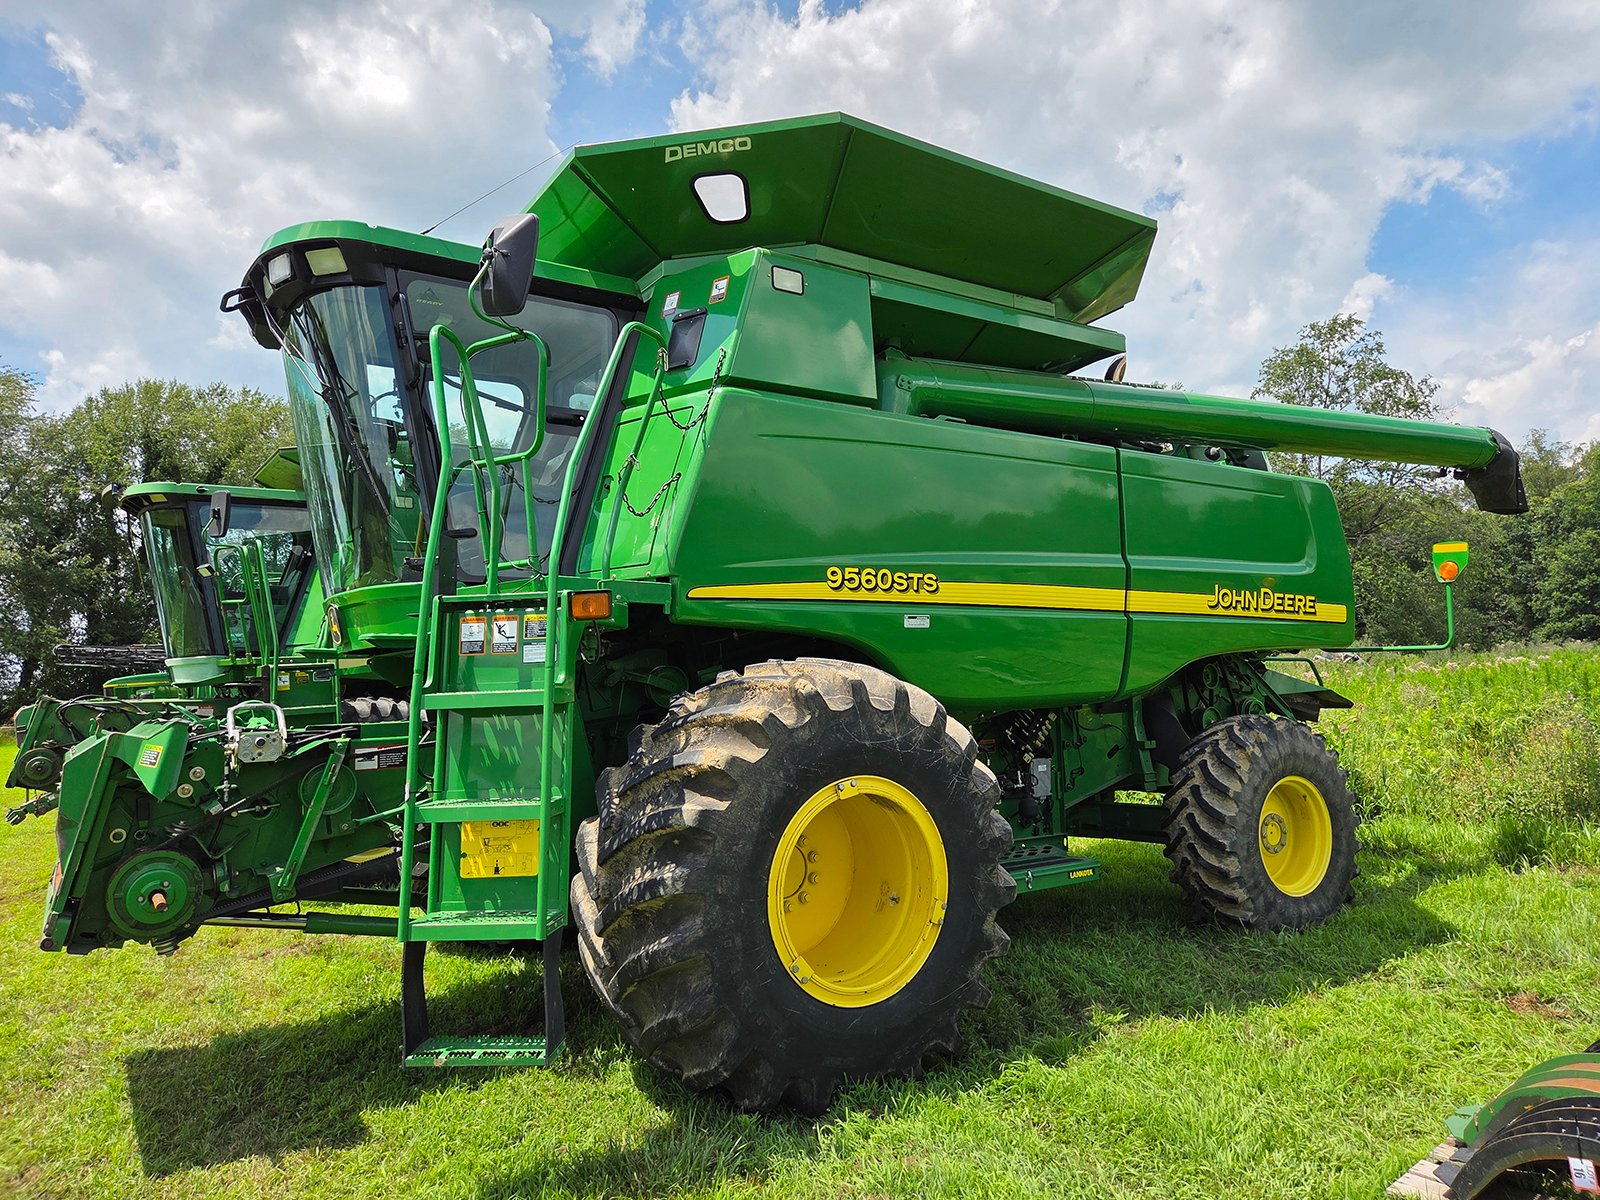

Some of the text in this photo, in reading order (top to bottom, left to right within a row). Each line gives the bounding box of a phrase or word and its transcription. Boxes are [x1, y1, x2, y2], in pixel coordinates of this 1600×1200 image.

[664, 136, 752, 164] DEMCO
[826, 565, 939, 593] 9560STS
[1207, 583, 1317, 614] JOHN DEERE
[1573, 1168, 1586, 1179] 16
